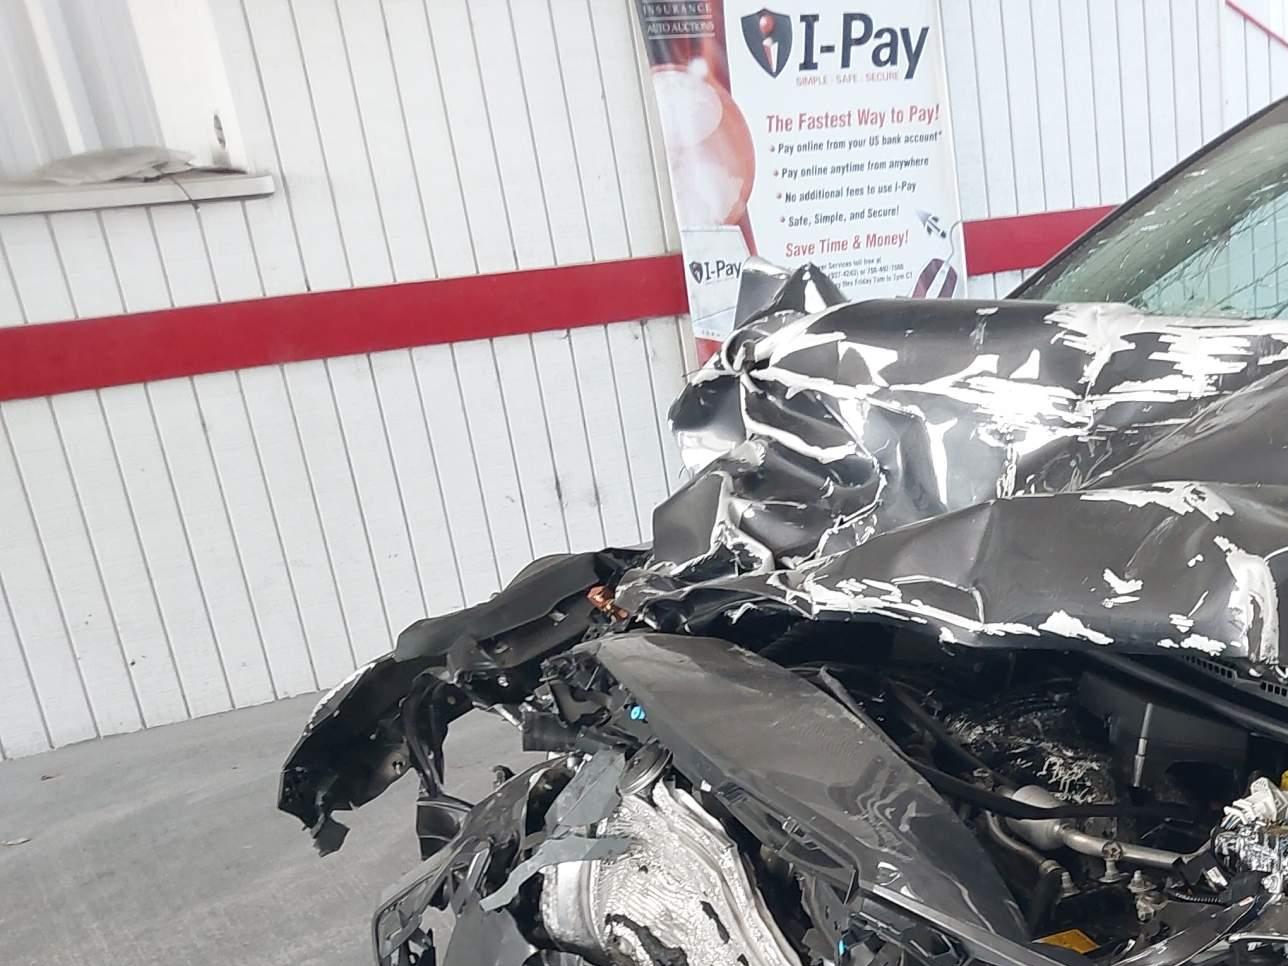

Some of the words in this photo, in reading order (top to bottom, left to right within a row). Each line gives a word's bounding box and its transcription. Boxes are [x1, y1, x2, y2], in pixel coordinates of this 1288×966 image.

[642, 2, 713, 17] INSURANCE
[647, 23, 671, 34] AUTO
[798, 12, 930, 80] I-Pay
[796, 75, 827, 87] SIMPLE
[836, 73, 857, 85] SAFE
[865, 71, 899, 83] SECURE
[766, 114, 793, 133] The
[798, 110, 852, 131] Fastest
[856, 107, 886, 129] Way
[891, 107, 904, 124] to
[909, 103, 940, 125] Pay!
[778, 143, 794, 156] Pay
[796, 139, 824, 153] online
[826, 138, 847, 151] from
[848, 138, 867, 151] your
[869, 136, 880, 147] US
[882, 133, 902, 146] bank
[781, 167, 798, 180] Pay
[800, 164, 828, 177] online
[830, 162, 865, 176] anytime
[867, 159, 887, 171] from
[888, 156, 930, 171] anywhere
[784, 192, 797, 203] No
[799, 187, 844, 202] additional
[846, 185, 864, 198] fees
[866, 184, 876, 195] to
[877, 183, 893, 194] use
[895, 180, 917, 193] I-Pay
[788, 215, 812, 228] Safe,
[814, 211, 847, 225] Simple,
[849, 209, 866, 221] and
[867, 204, 900, 219] Secure!
[785, 242, 816, 258] Save
[819, 237, 849, 254] Time
[852, 235, 862, 250] &
[865, 229, 910, 249] Money!
[703, 259, 742, 281] I-Pay
